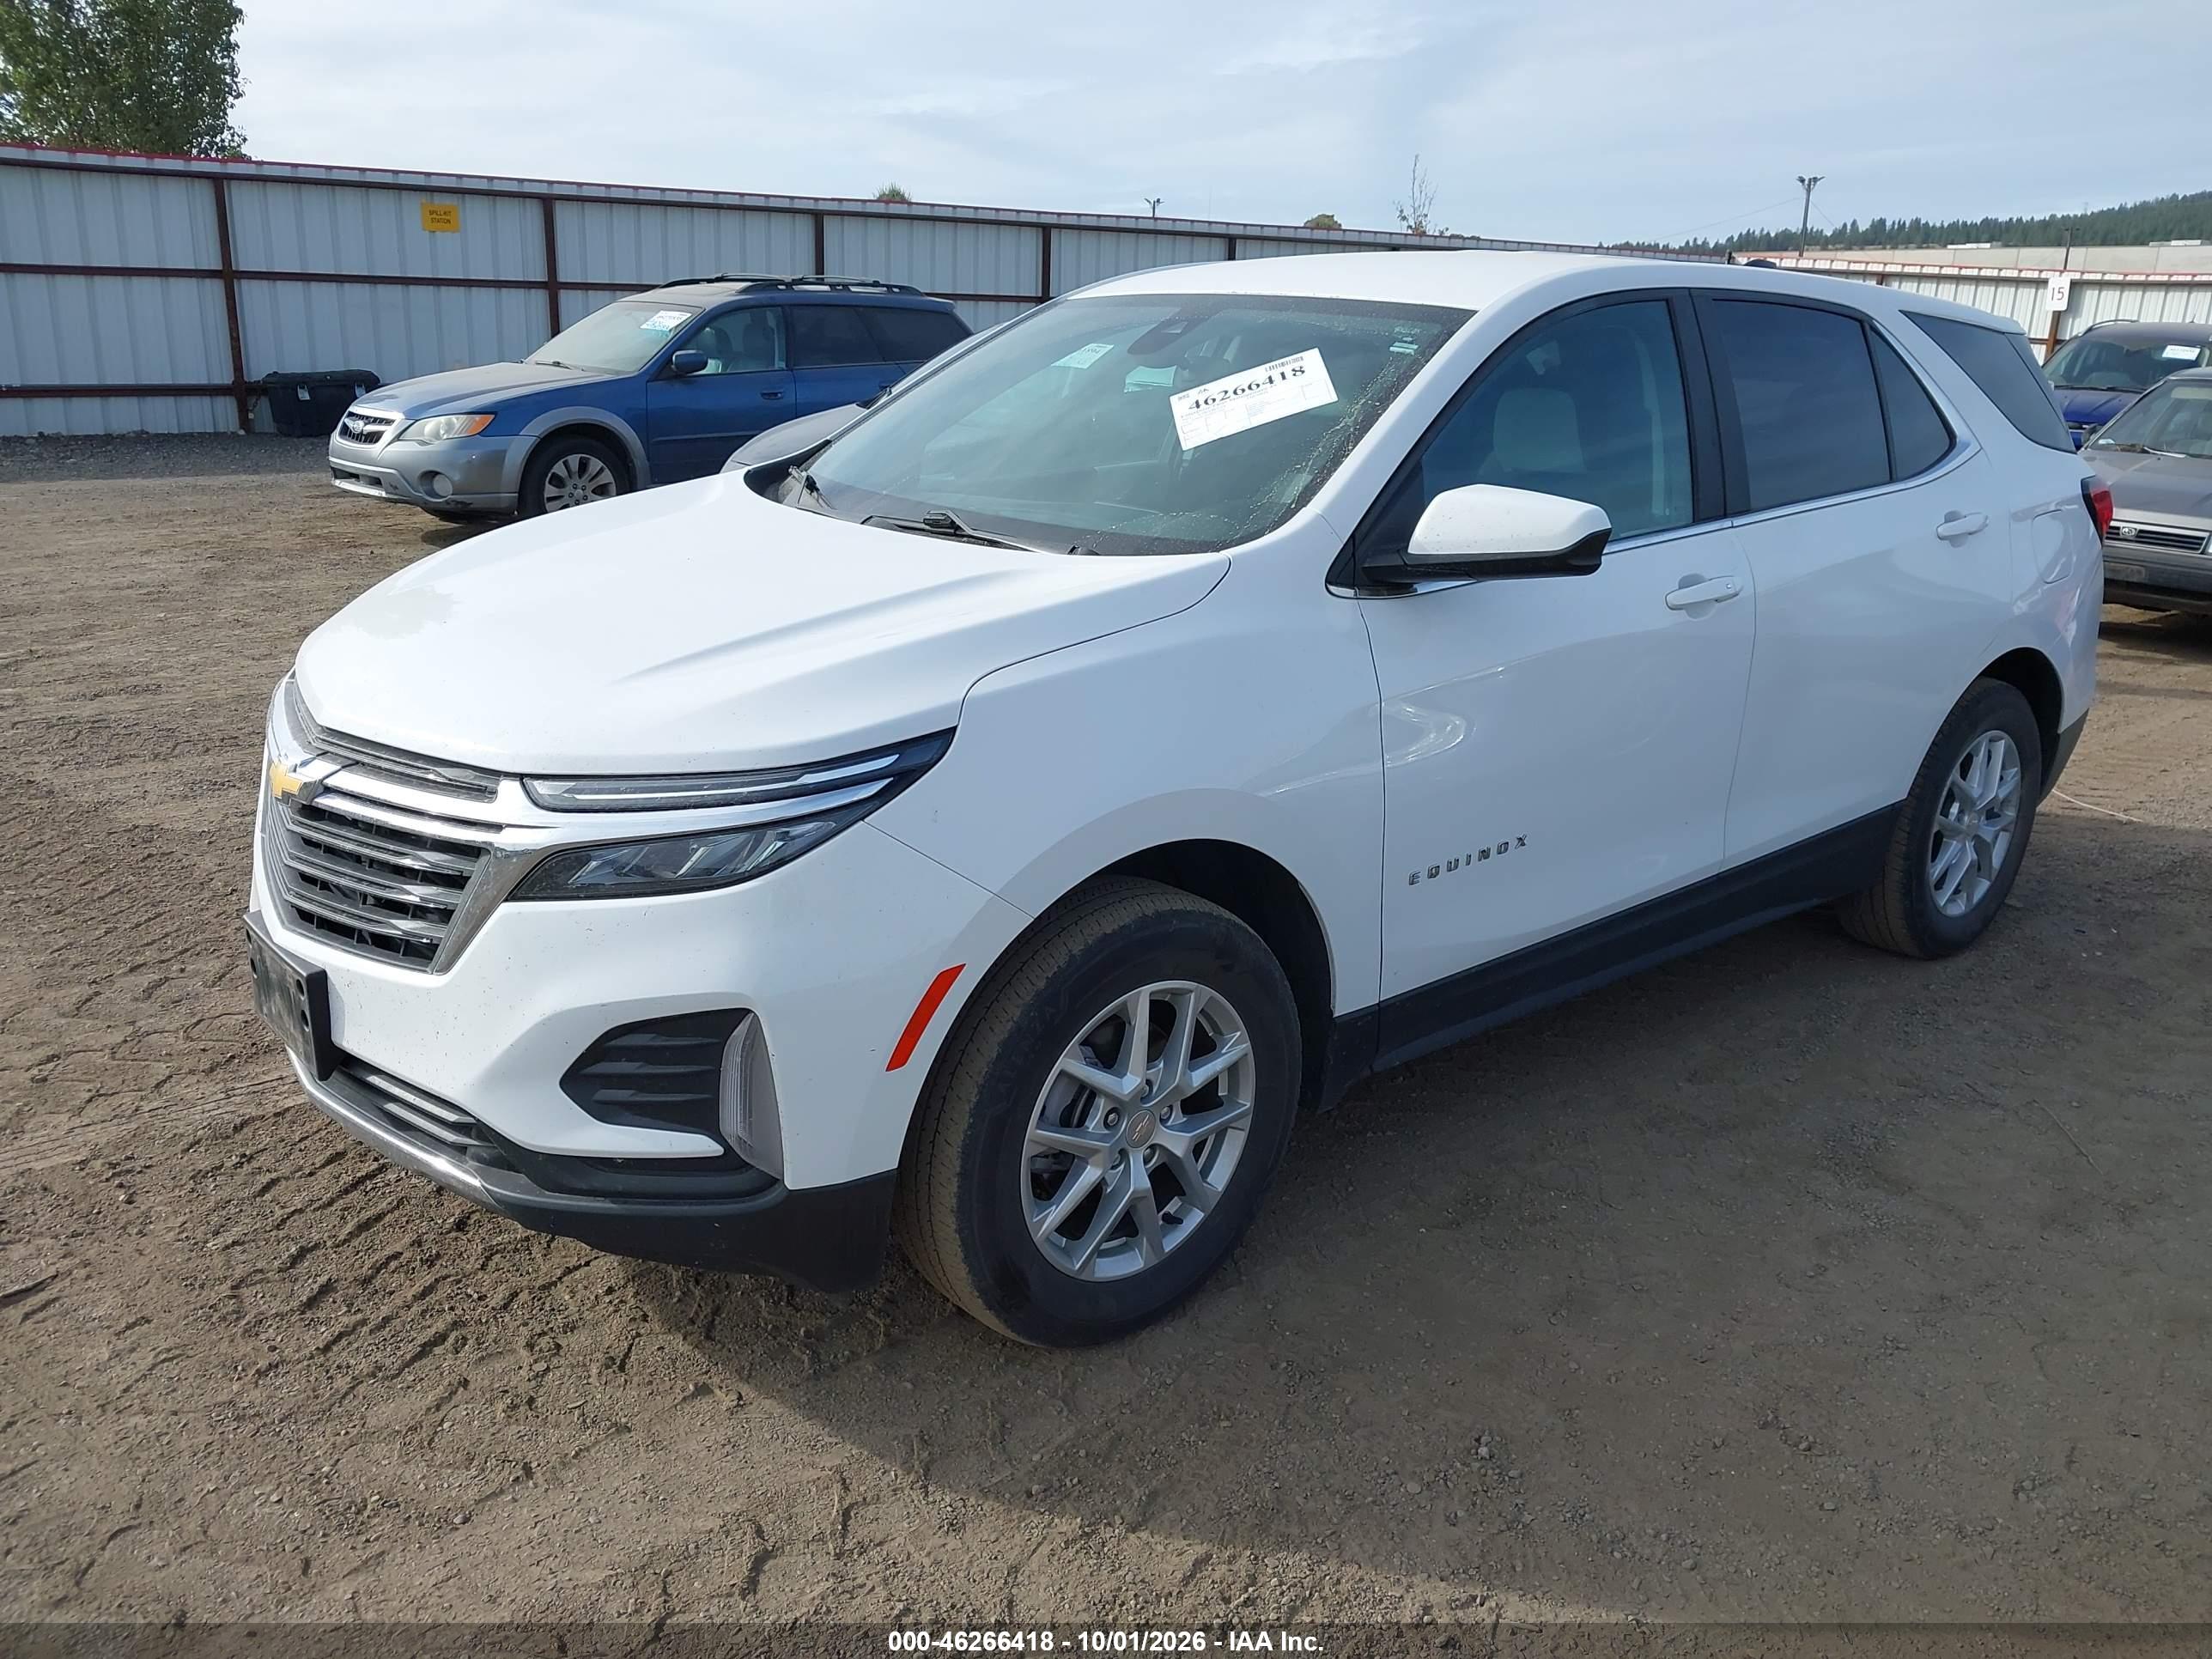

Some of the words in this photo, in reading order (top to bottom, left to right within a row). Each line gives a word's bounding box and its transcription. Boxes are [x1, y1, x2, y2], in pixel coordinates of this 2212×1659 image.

[2051, 287, 2065, 301] 15
[1188, 365, 1306, 410] 46266418
[1408, 834, 1528, 886] EQUINOX
